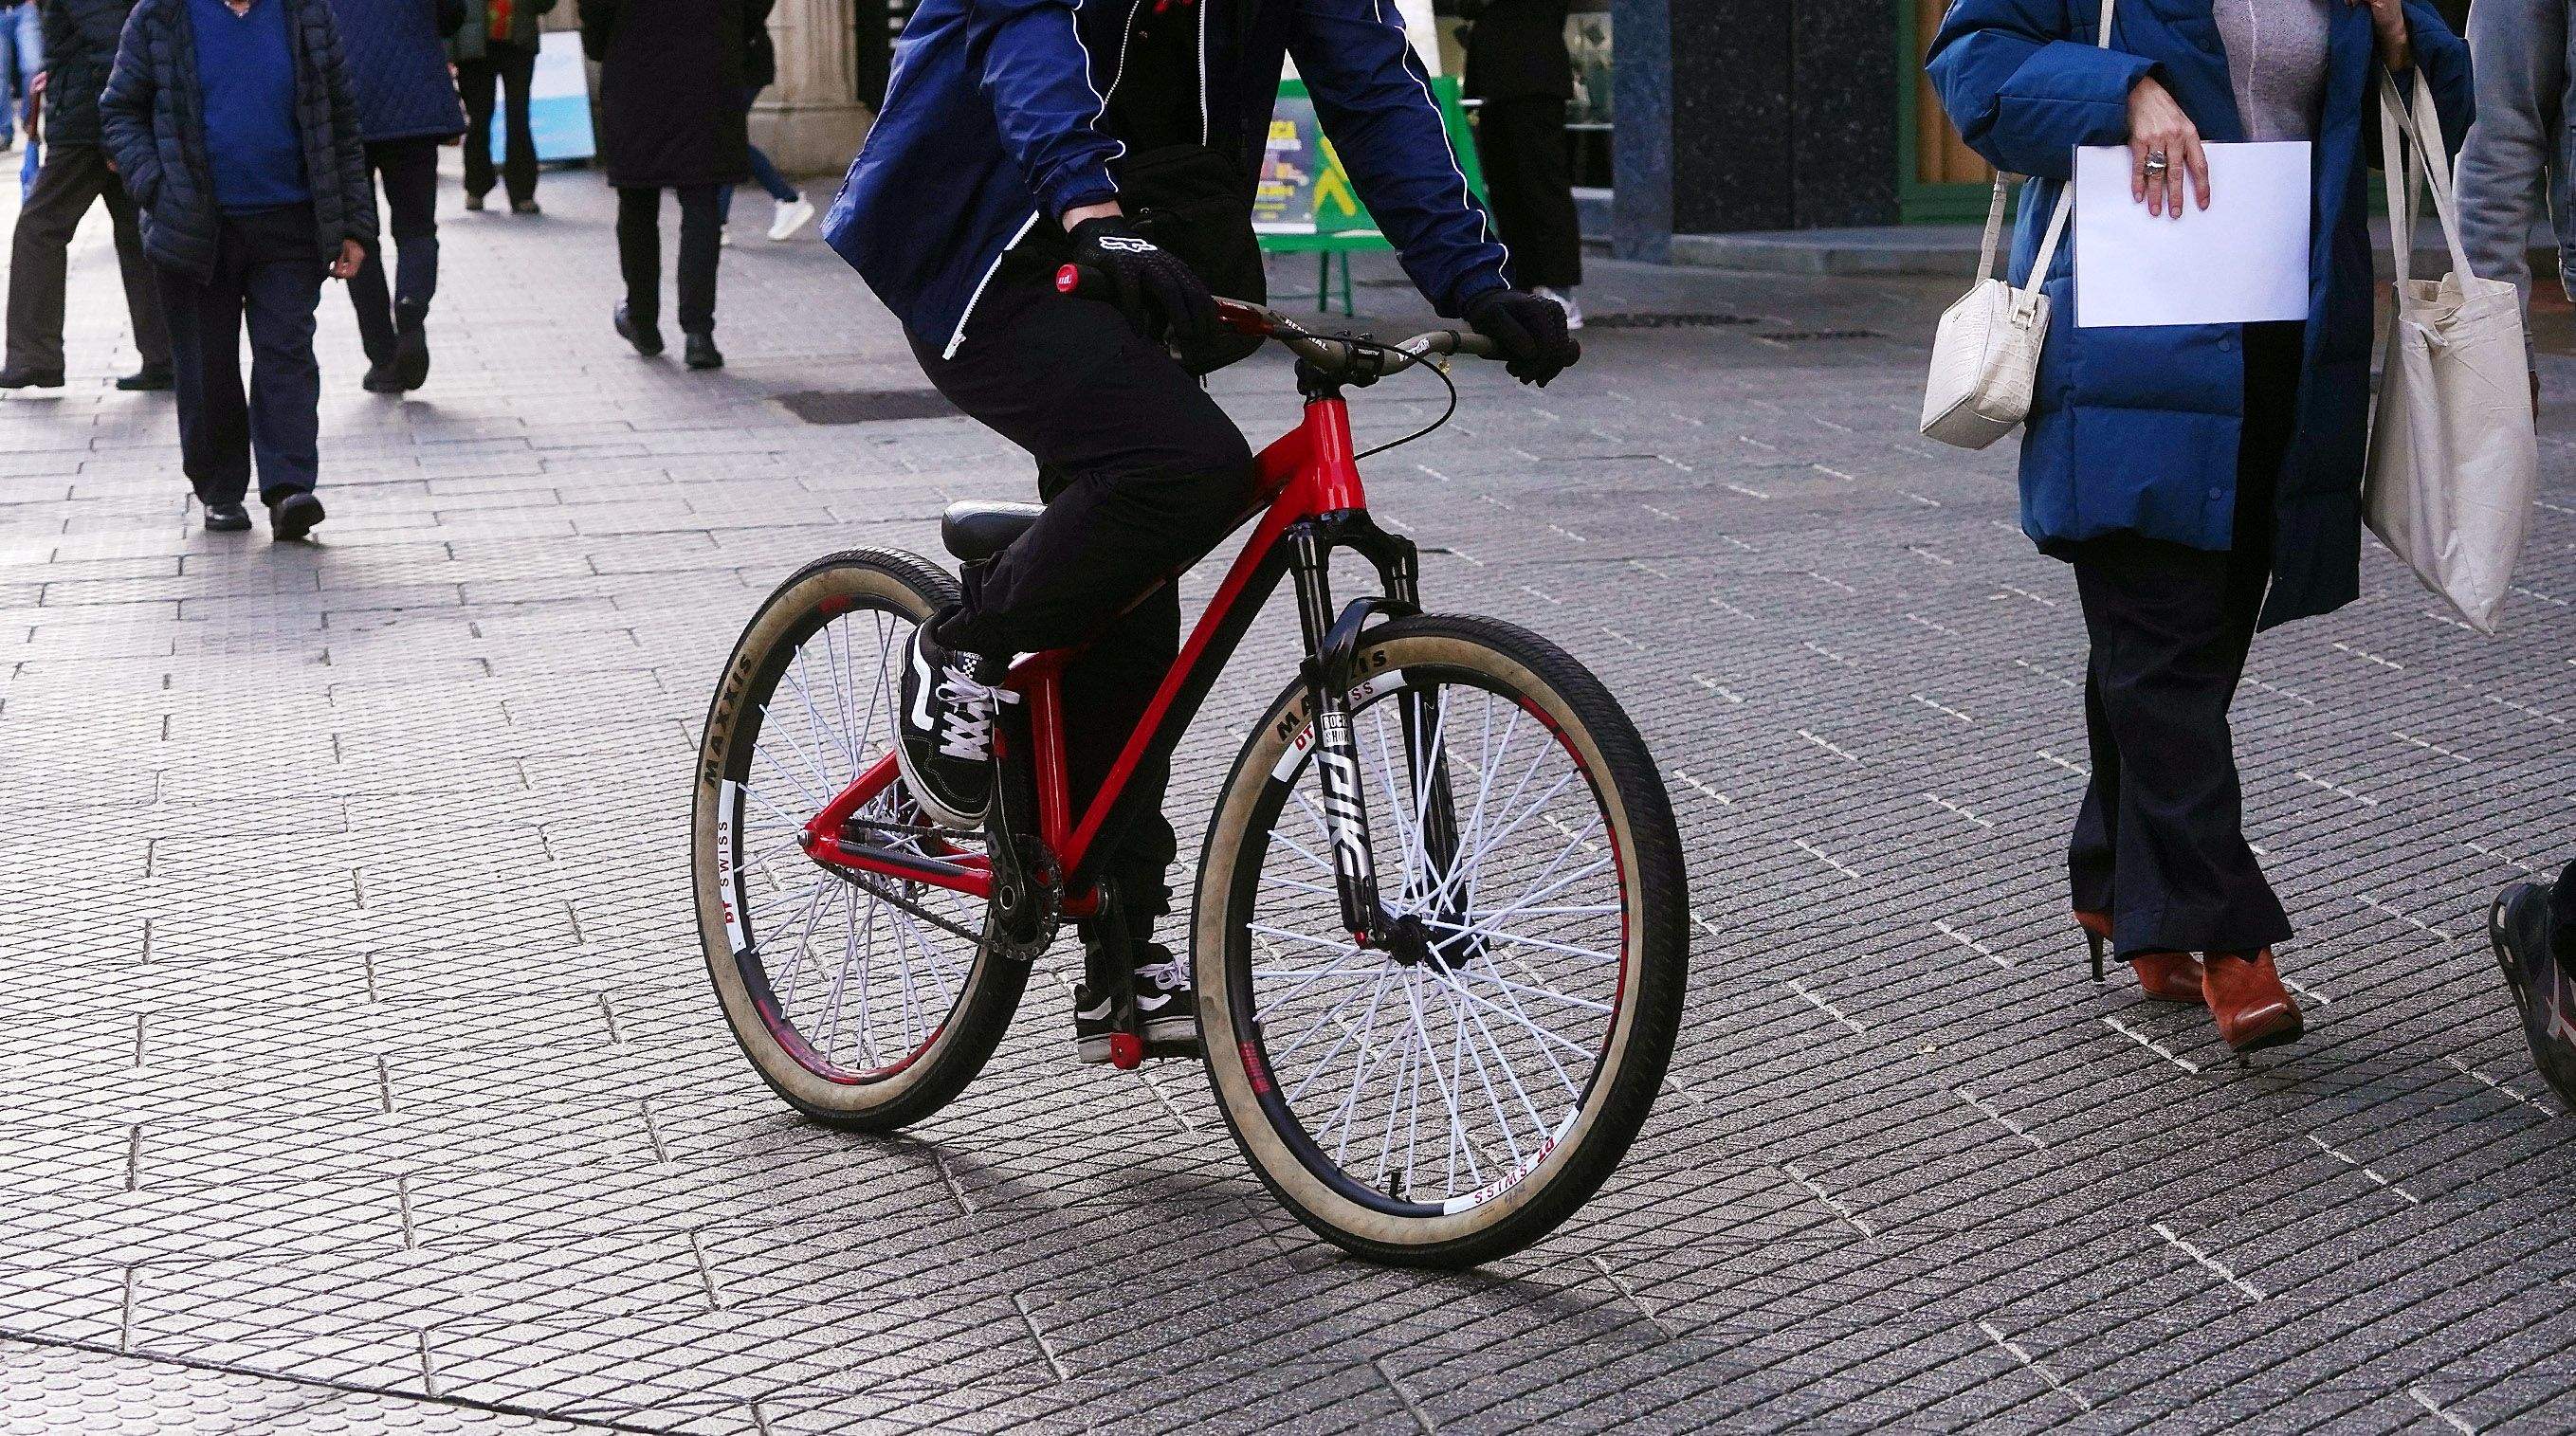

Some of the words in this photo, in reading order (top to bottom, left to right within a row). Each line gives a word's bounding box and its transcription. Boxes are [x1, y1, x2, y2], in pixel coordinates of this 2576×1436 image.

[963, 651, 981, 661] VANS
[703, 653, 751, 790] MAXXIS
[1295, 723, 1314, 751] DT
[718, 821, 729, 887] SWISS
[722, 900, 735, 925] DT
[1537, 1136, 1555, 1164] DT
[1473, 1164, 1527, 1204] SWISS
